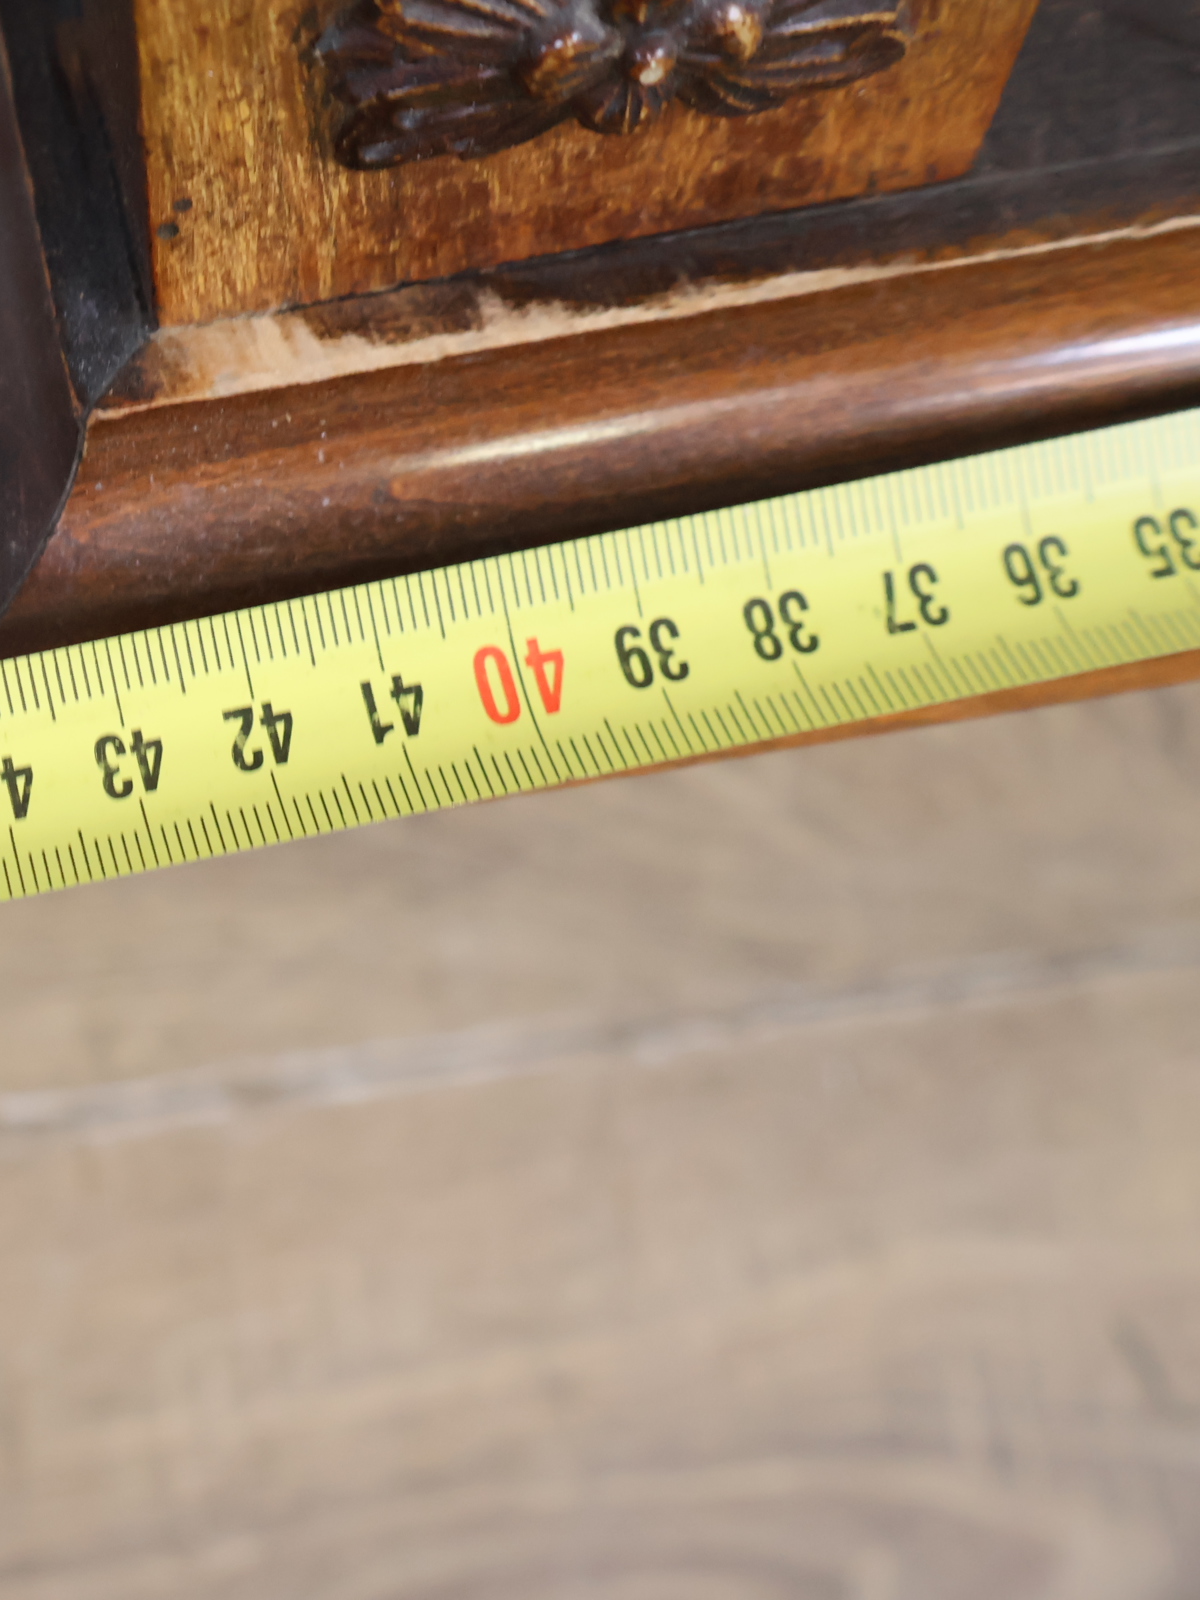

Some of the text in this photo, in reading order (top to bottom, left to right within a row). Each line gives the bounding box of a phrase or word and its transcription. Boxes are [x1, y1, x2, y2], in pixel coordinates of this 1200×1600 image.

[1004, 536, 1078, 606] 36
[1134, 509, 1200, 578] 35
[743, 591, 819, 661] 38
[884, 563, 949, 634] 37
[474, 637, 564, 725] 40
[614, 618, 689, 689] 39
[222, 701, 293, 772] 42
[361, 674, 424, 745] 41
[94, 729, 163, 799] 43
